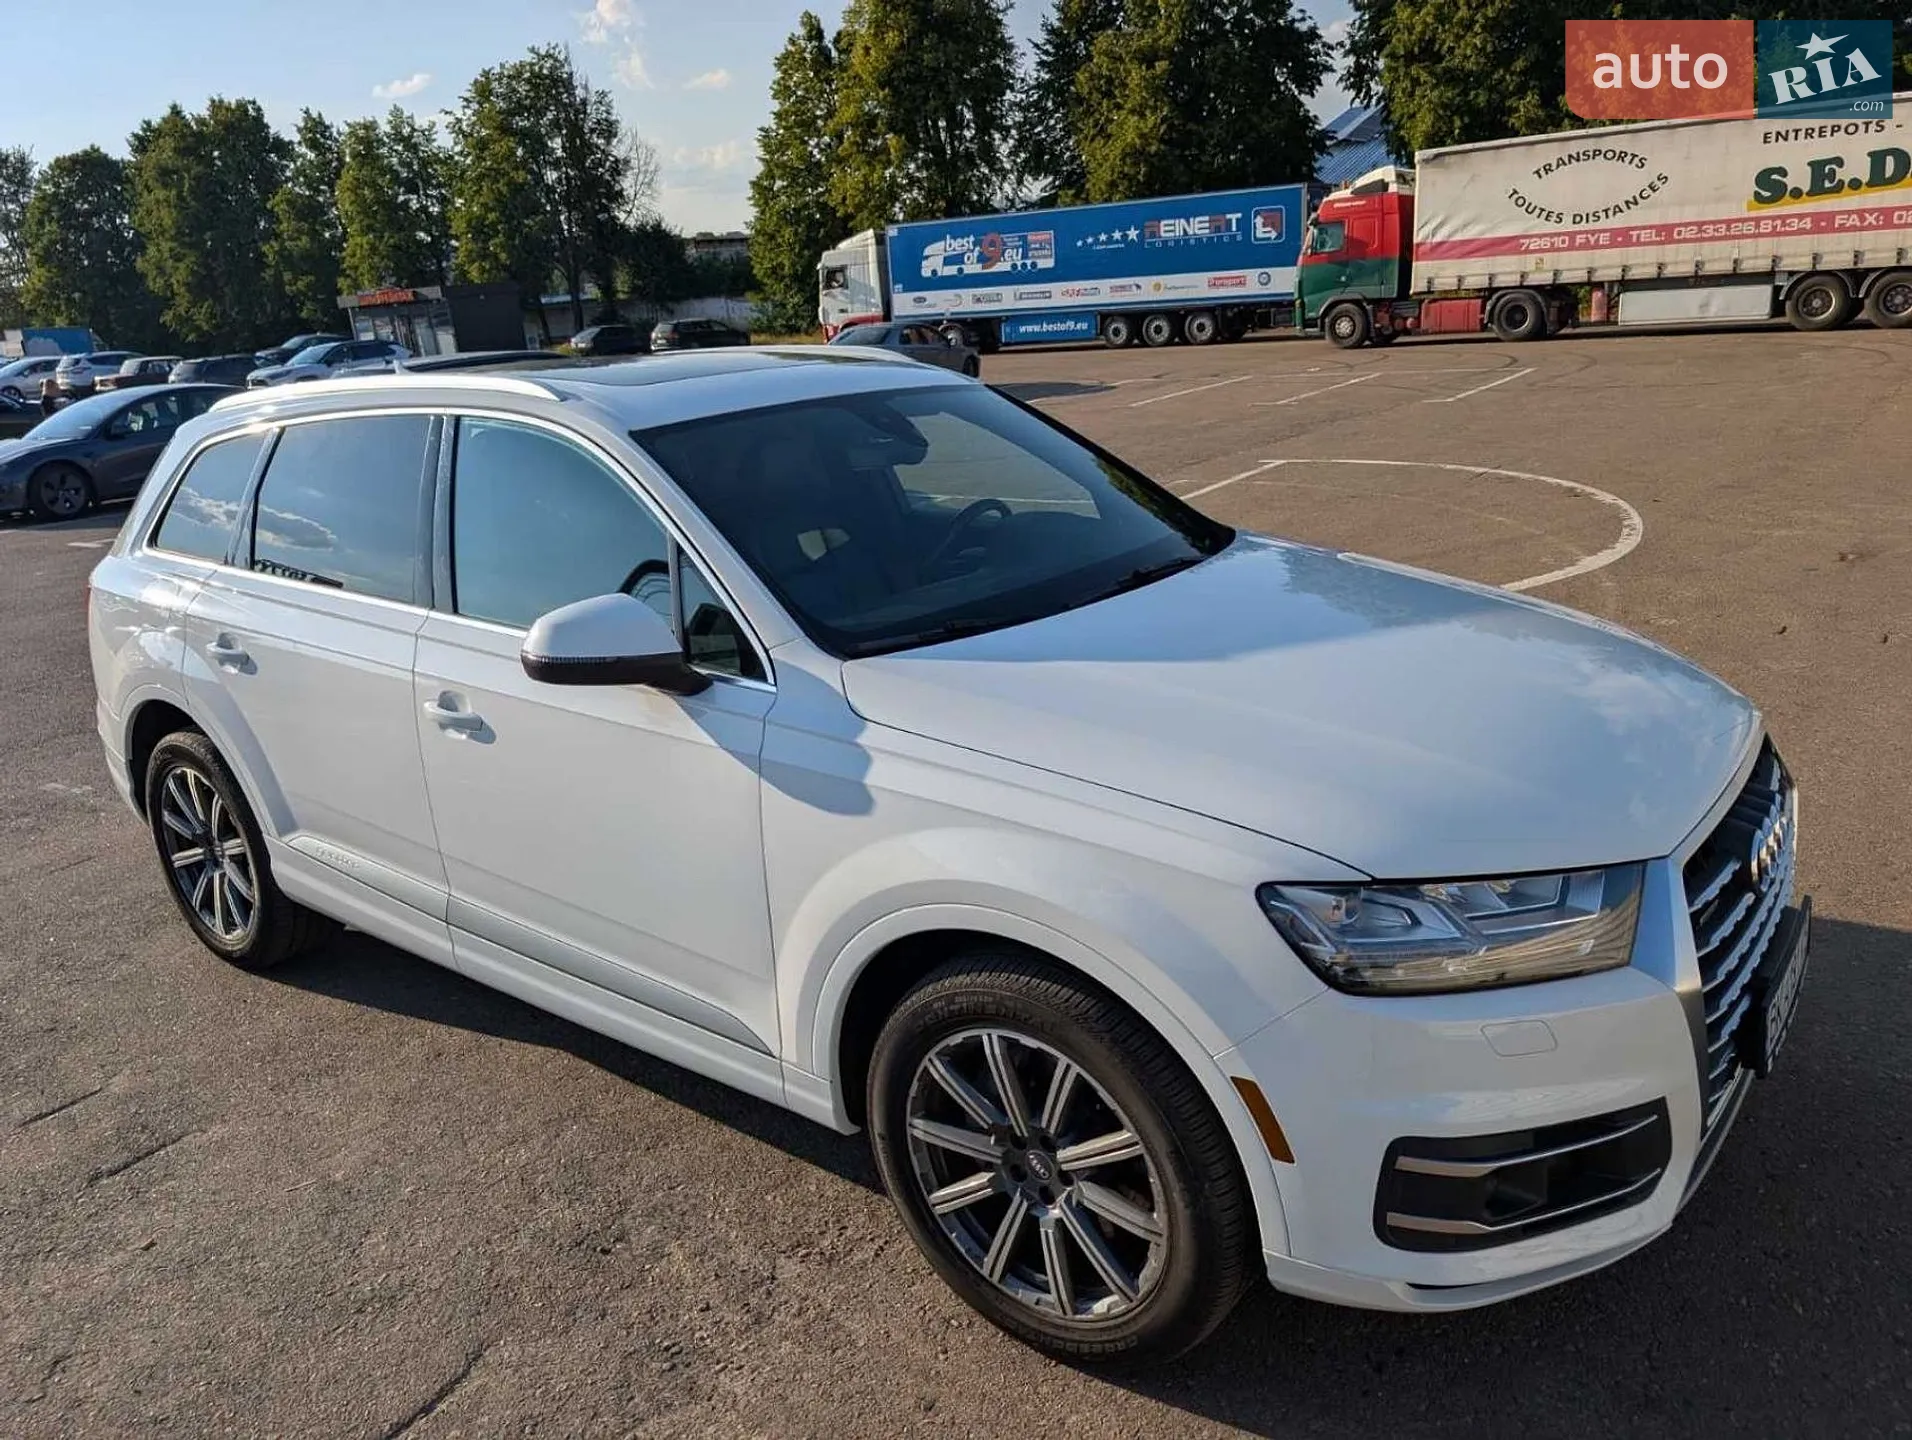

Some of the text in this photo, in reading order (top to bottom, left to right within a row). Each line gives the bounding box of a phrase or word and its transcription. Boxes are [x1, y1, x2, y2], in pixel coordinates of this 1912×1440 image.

[1762, 119, 1886, 144] ENTREPOTS
[1533, 148, 1648, 180] TRANSPORTS
[1507, 172, 1669, 225] TOUTES DISTANCES
[1143, 212, 1243, 238] REINERT
[1519, 235, 1569, 251] 72610
[1575, 232, 1611, 247] FYE
[1628, 229, 1666, 243] TEL:
[1834, 212, 1884, 228] FAX:
[945, 234, 975, 251] best
[963, 247, 980, 264] of
[1019, 319, 1089, 333] www.bestof9.eu
